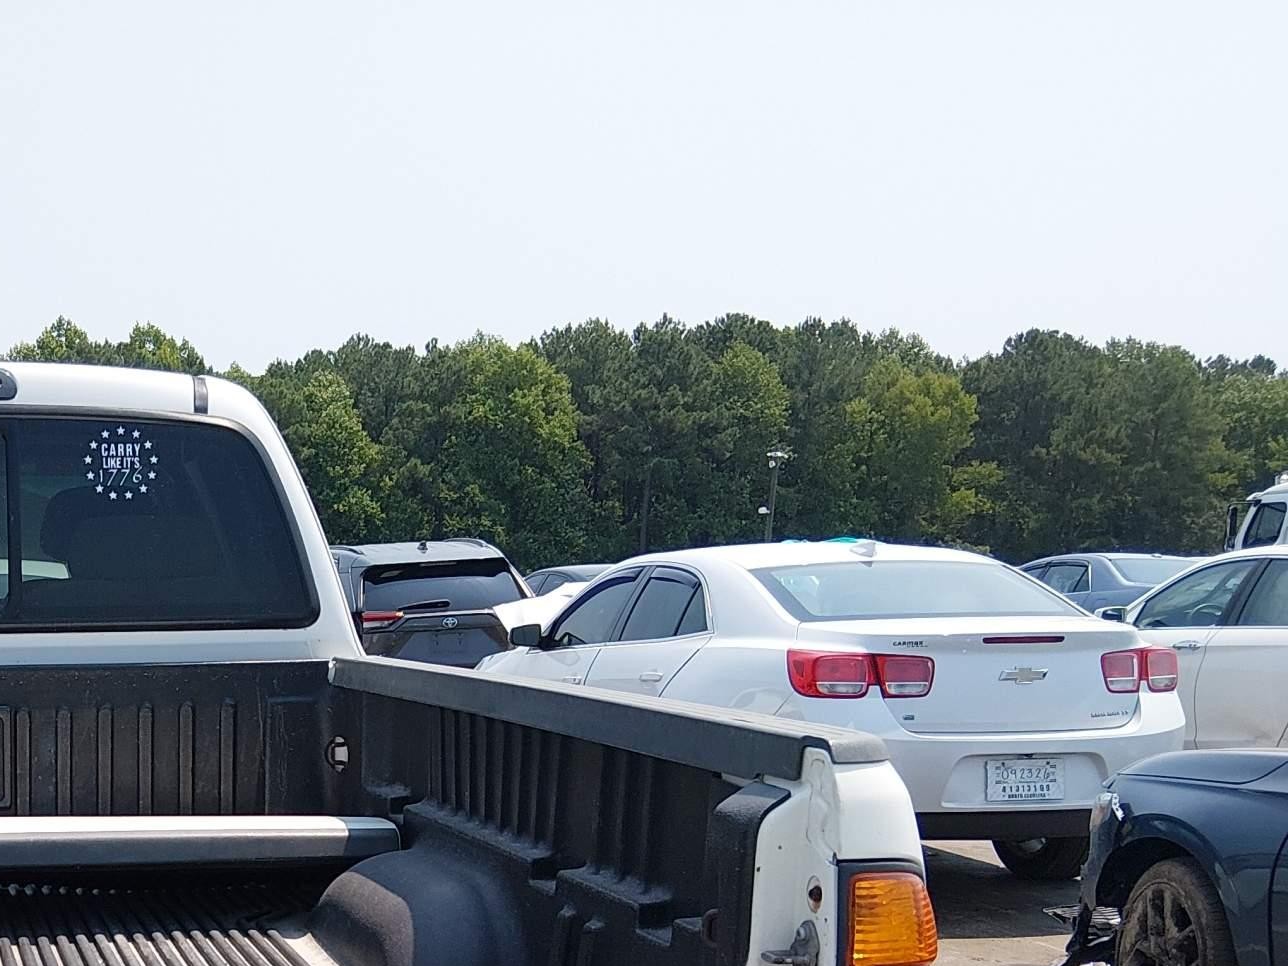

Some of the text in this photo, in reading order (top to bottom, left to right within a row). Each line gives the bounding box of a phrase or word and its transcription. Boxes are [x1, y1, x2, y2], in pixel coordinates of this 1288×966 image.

[101, 443, 141, 457] CARRY
[102, 457, 140, 469] LIKE IT'S
[99, 465, 143, 486] 1776
